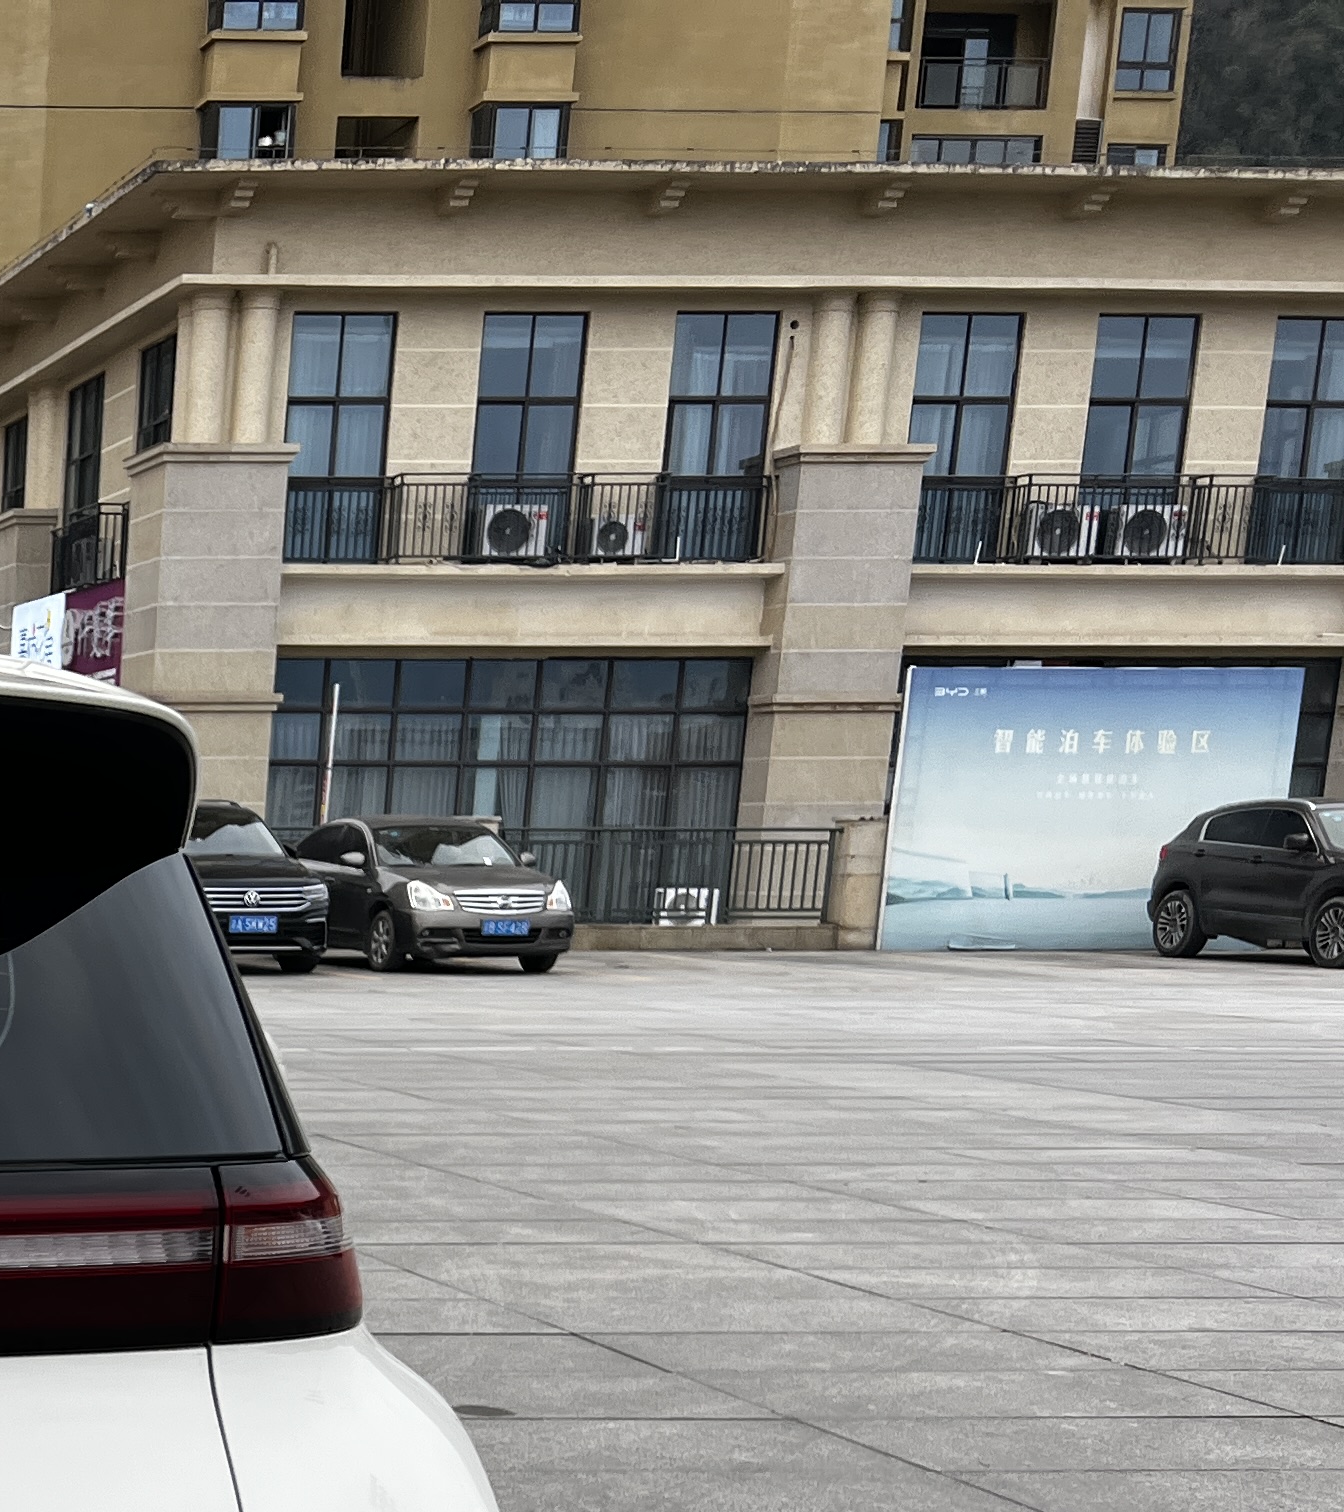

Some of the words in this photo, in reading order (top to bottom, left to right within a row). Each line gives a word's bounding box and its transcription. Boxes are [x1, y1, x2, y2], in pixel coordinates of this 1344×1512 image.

[934, 686, 970, 697] BYD
[994, 728, 1211, 754] 智能泊车体验区
